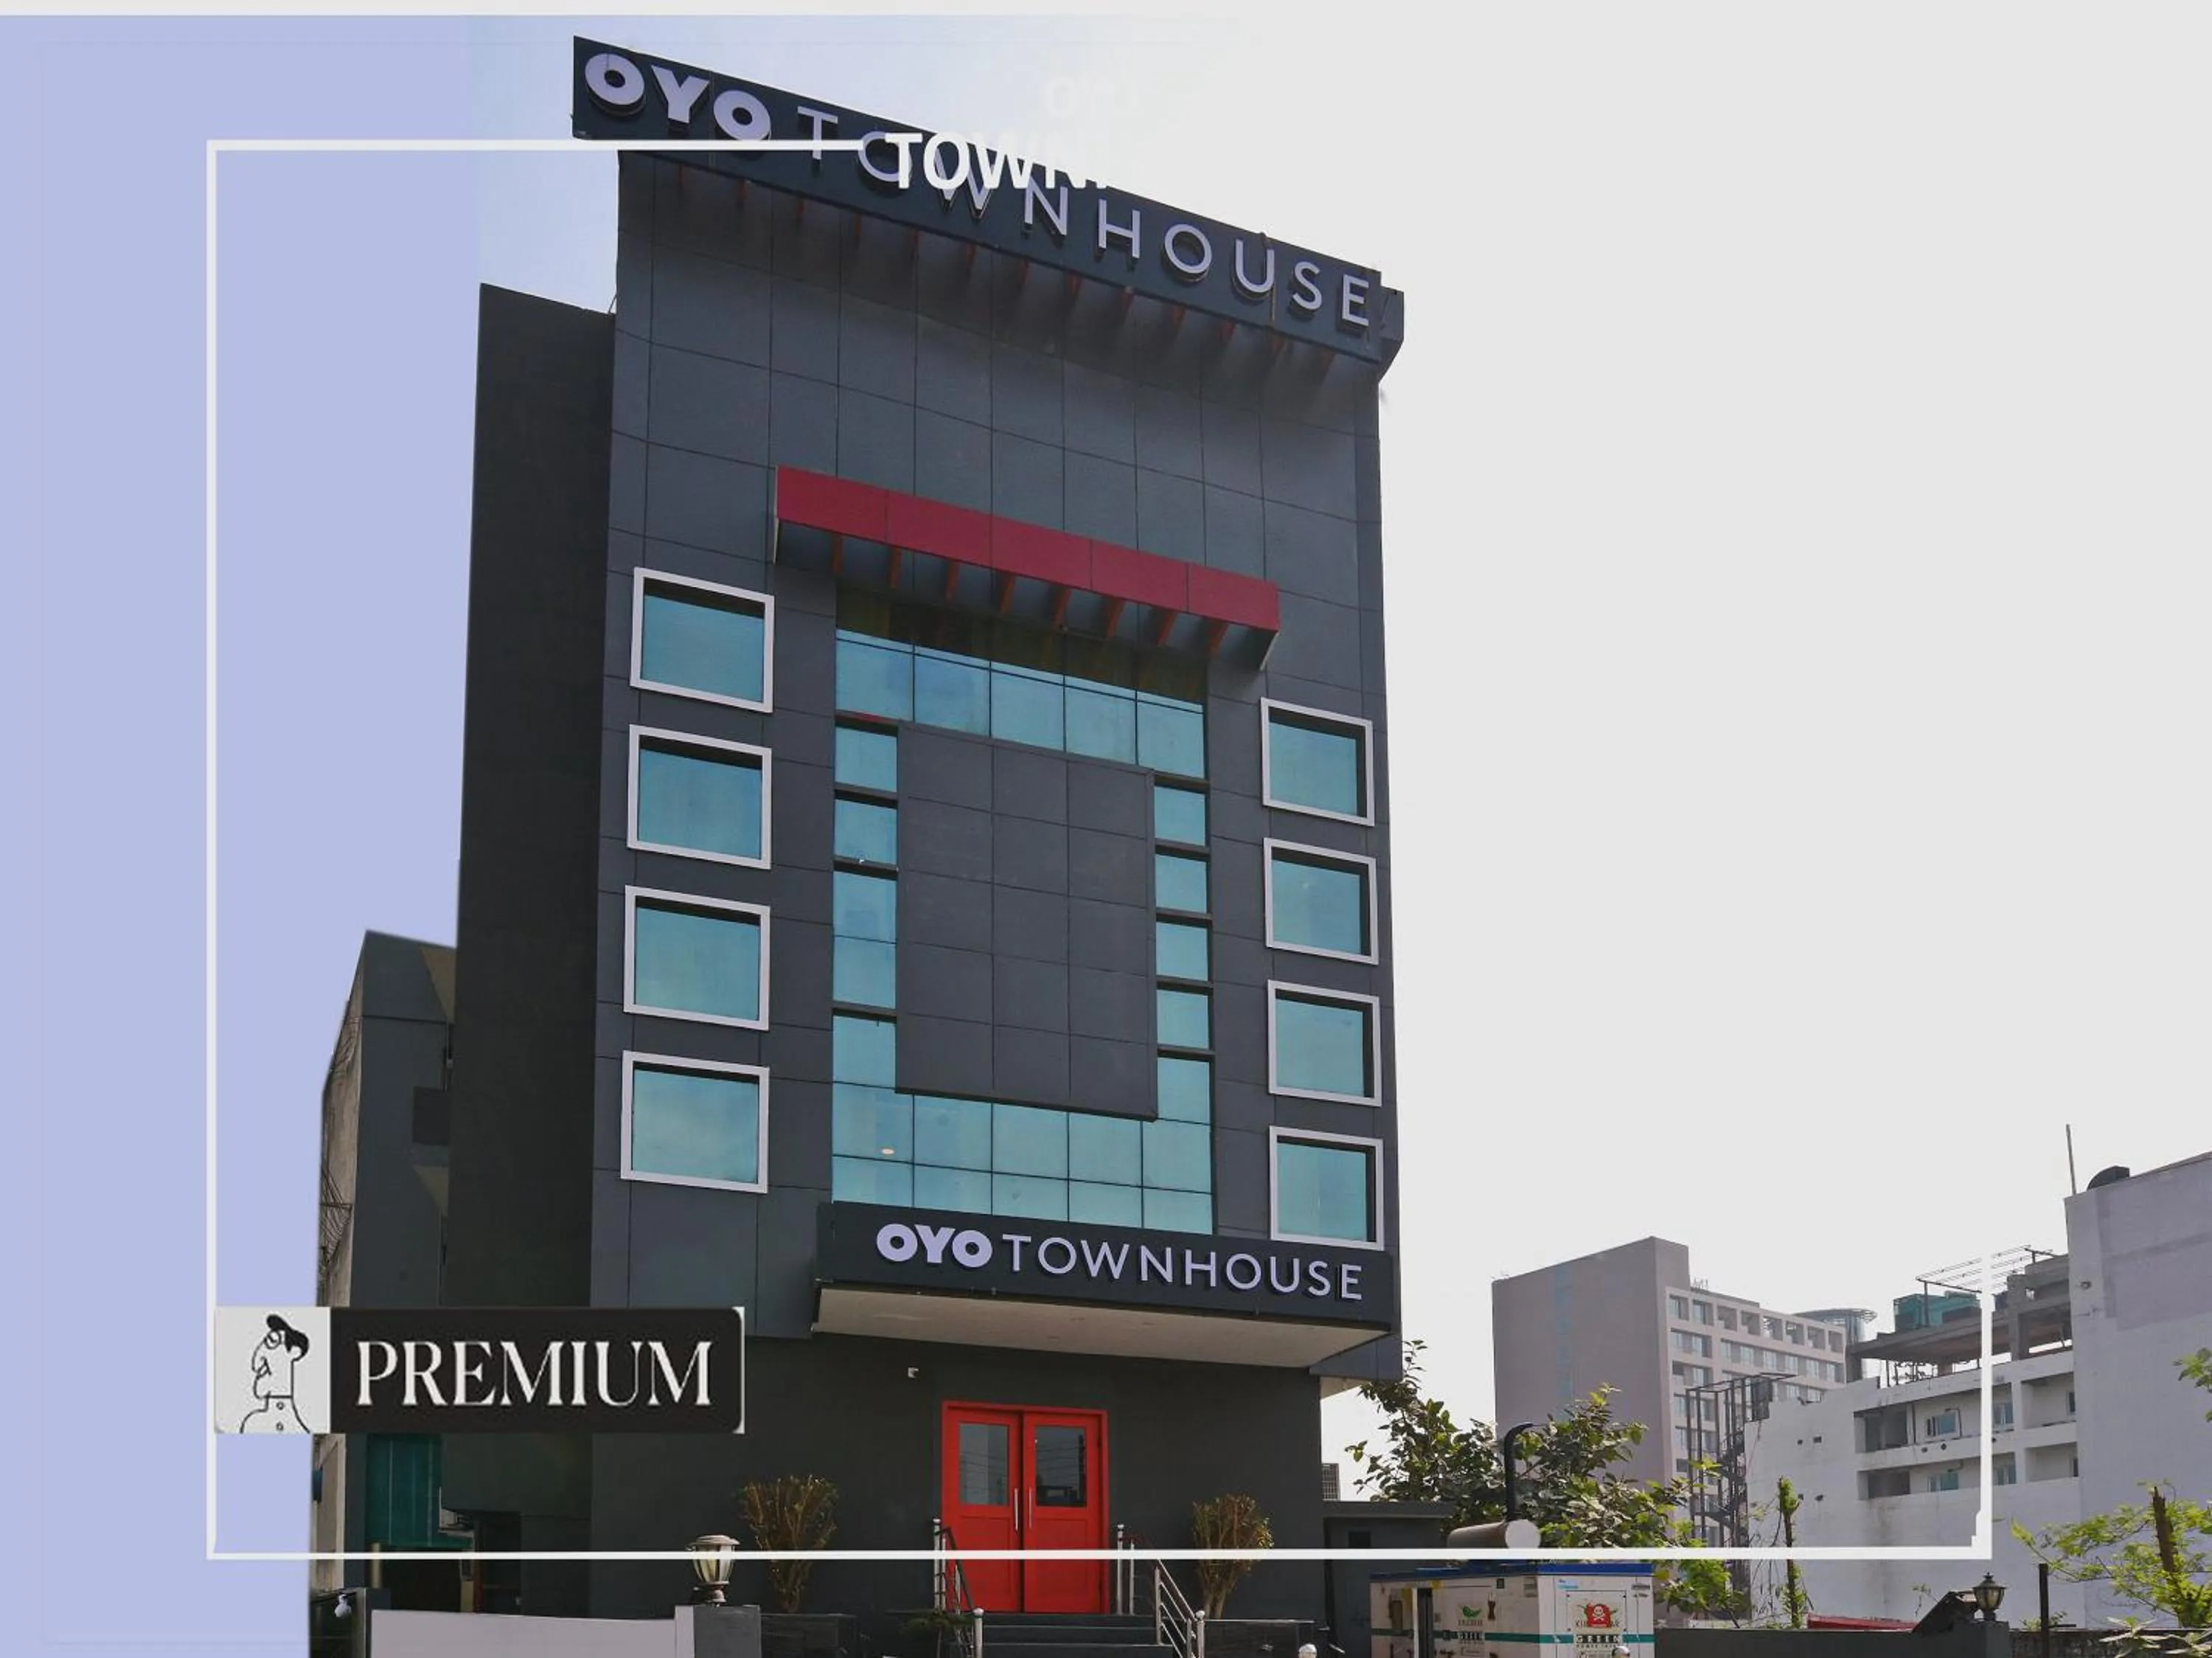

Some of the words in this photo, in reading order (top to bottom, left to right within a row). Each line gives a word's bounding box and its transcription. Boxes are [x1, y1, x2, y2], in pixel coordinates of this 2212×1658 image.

[585, 53, 772, 141] OYO
[876, 1223, 992, 1268] OYO
[1002, 1233, 1363, 1300] TOWNHOUSE
